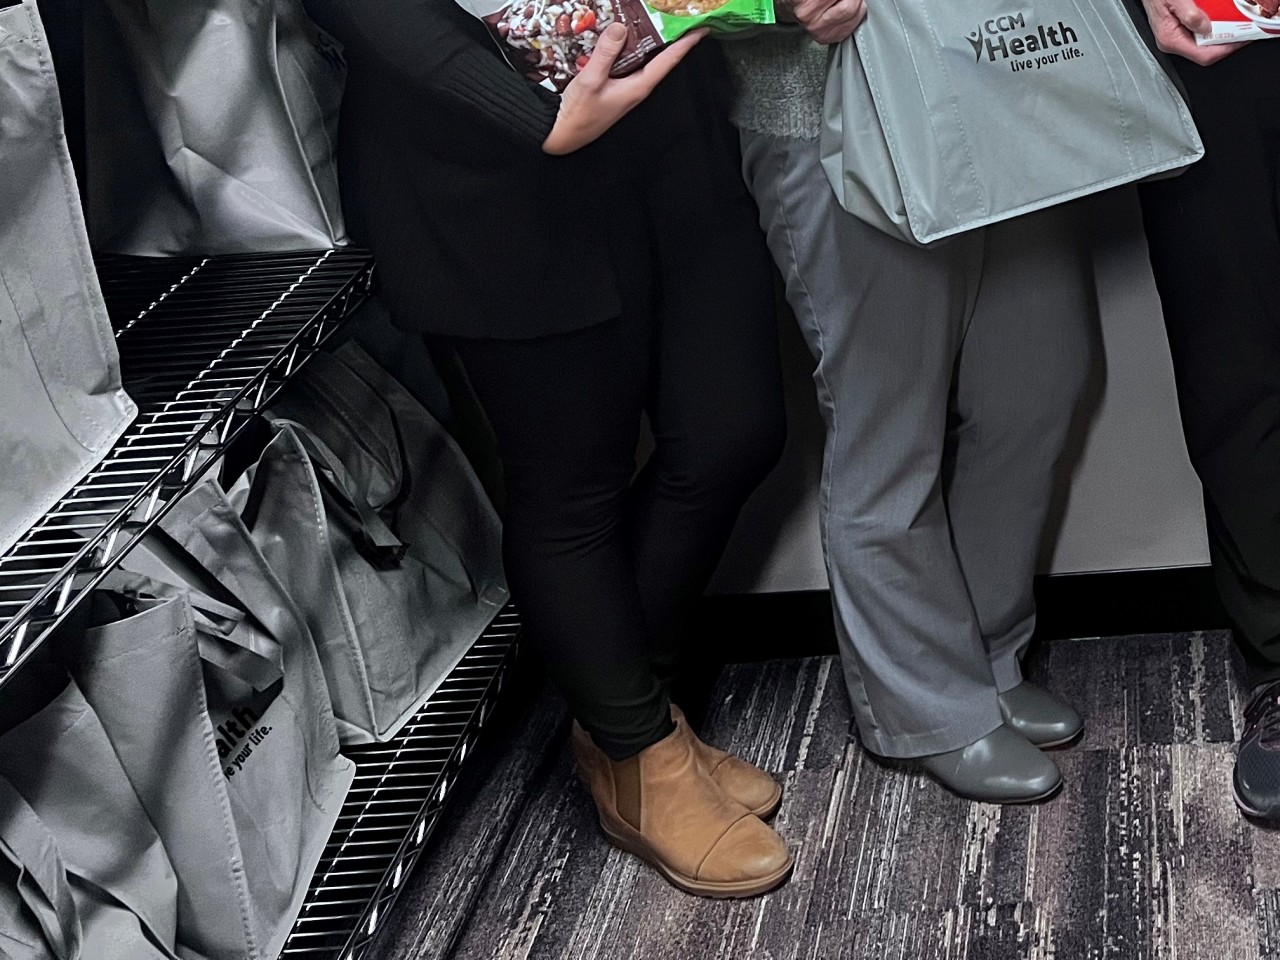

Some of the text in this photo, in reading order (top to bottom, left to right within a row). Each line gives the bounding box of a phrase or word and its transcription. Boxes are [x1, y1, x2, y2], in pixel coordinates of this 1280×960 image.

[984, 12, 1025, 35] CCM
[984, 21, 1078, 62] Health
[1010, 46, 1084, 72] live your life.
[215, 707, 260, 759] alth
[232, 742, 253, 771] your
[248, 726, 273, 746] life.
